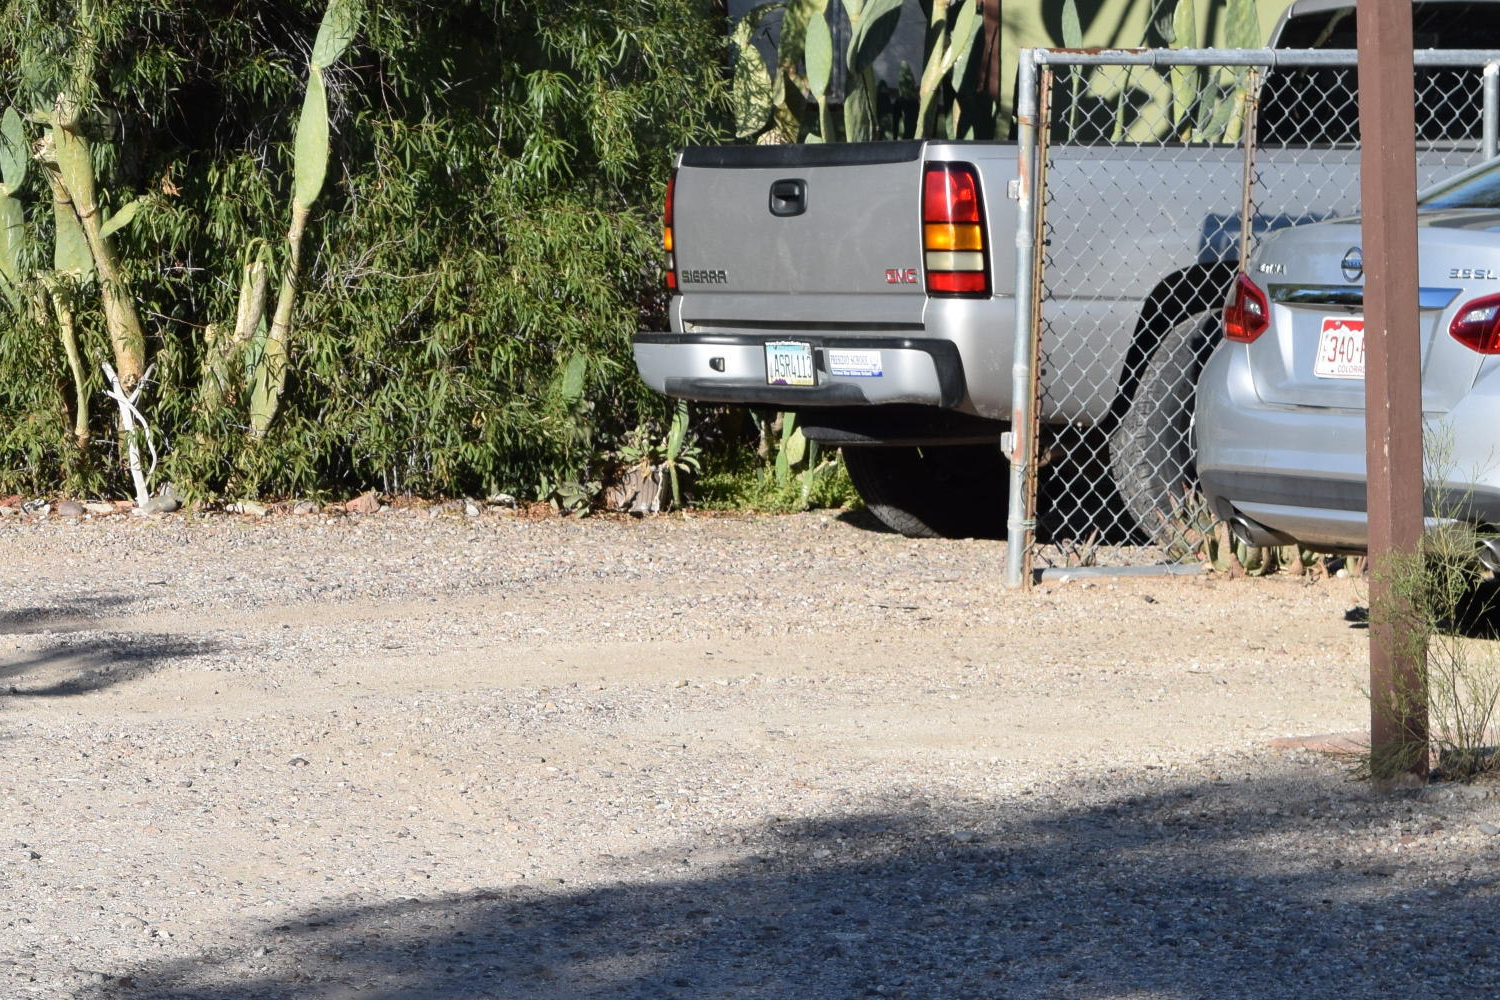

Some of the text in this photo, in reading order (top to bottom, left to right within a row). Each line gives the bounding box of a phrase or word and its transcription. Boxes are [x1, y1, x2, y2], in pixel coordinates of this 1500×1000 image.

[681, 270, 727, 283] SIERRA
[884, 269, 917, 283] GMC
[1337, 364, 1364, 373] COLORA
